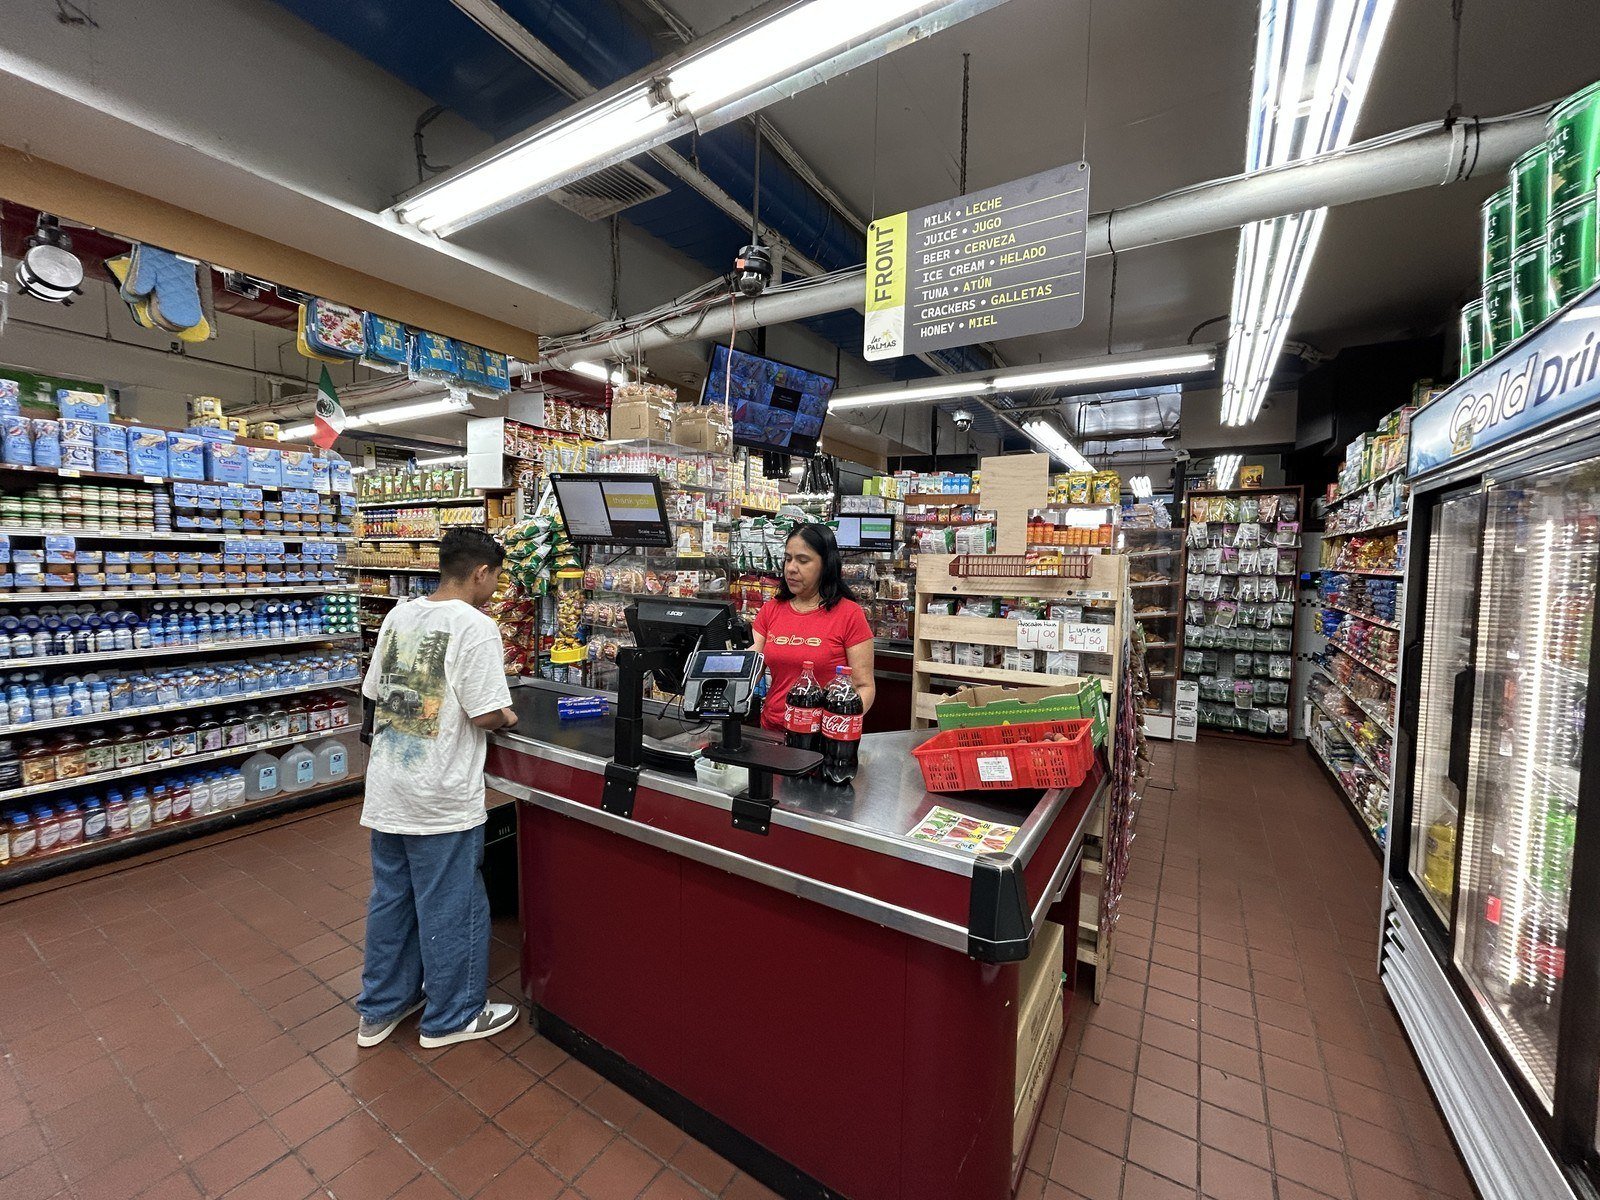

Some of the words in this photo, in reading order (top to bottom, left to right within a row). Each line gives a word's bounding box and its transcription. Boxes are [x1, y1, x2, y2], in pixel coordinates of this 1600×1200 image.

[923, 210, 952, 228] MILK
[965, 196, 1003, 216] LECHE
[923, 228, 958, 246] JUICE
[972, 217, 1002, 234] JUGO
[923, 249, 951, 265] BEER
[964, 234, 1016, 255] CERVEZA
[874, 227, 894, 303] FRONT
[922, 271, 943, 284] ICE
[949, 260, 985, 277] CREAM
[999, 246, 1047, 266] HELADO
[920, 299, 976, 319] CRACKERS
[990, 284, 1053, 306] GALLETAS
[921, 286, 949, 301] TUNA
[962, 276, 993, 293] ATÚN
[920, 322, 955, 338] HONEY
[968, 315, 998, 330] MIEL
[866, 340, 897, 352] PALMAS
[1449, 351, 1539, 444] Cold
[219, 458, 243, 466] Gerber
[613, 497, 634, 505] thank
[635, 498, 649, 506] you
[1068, 625, 1101, 637] Lychee
